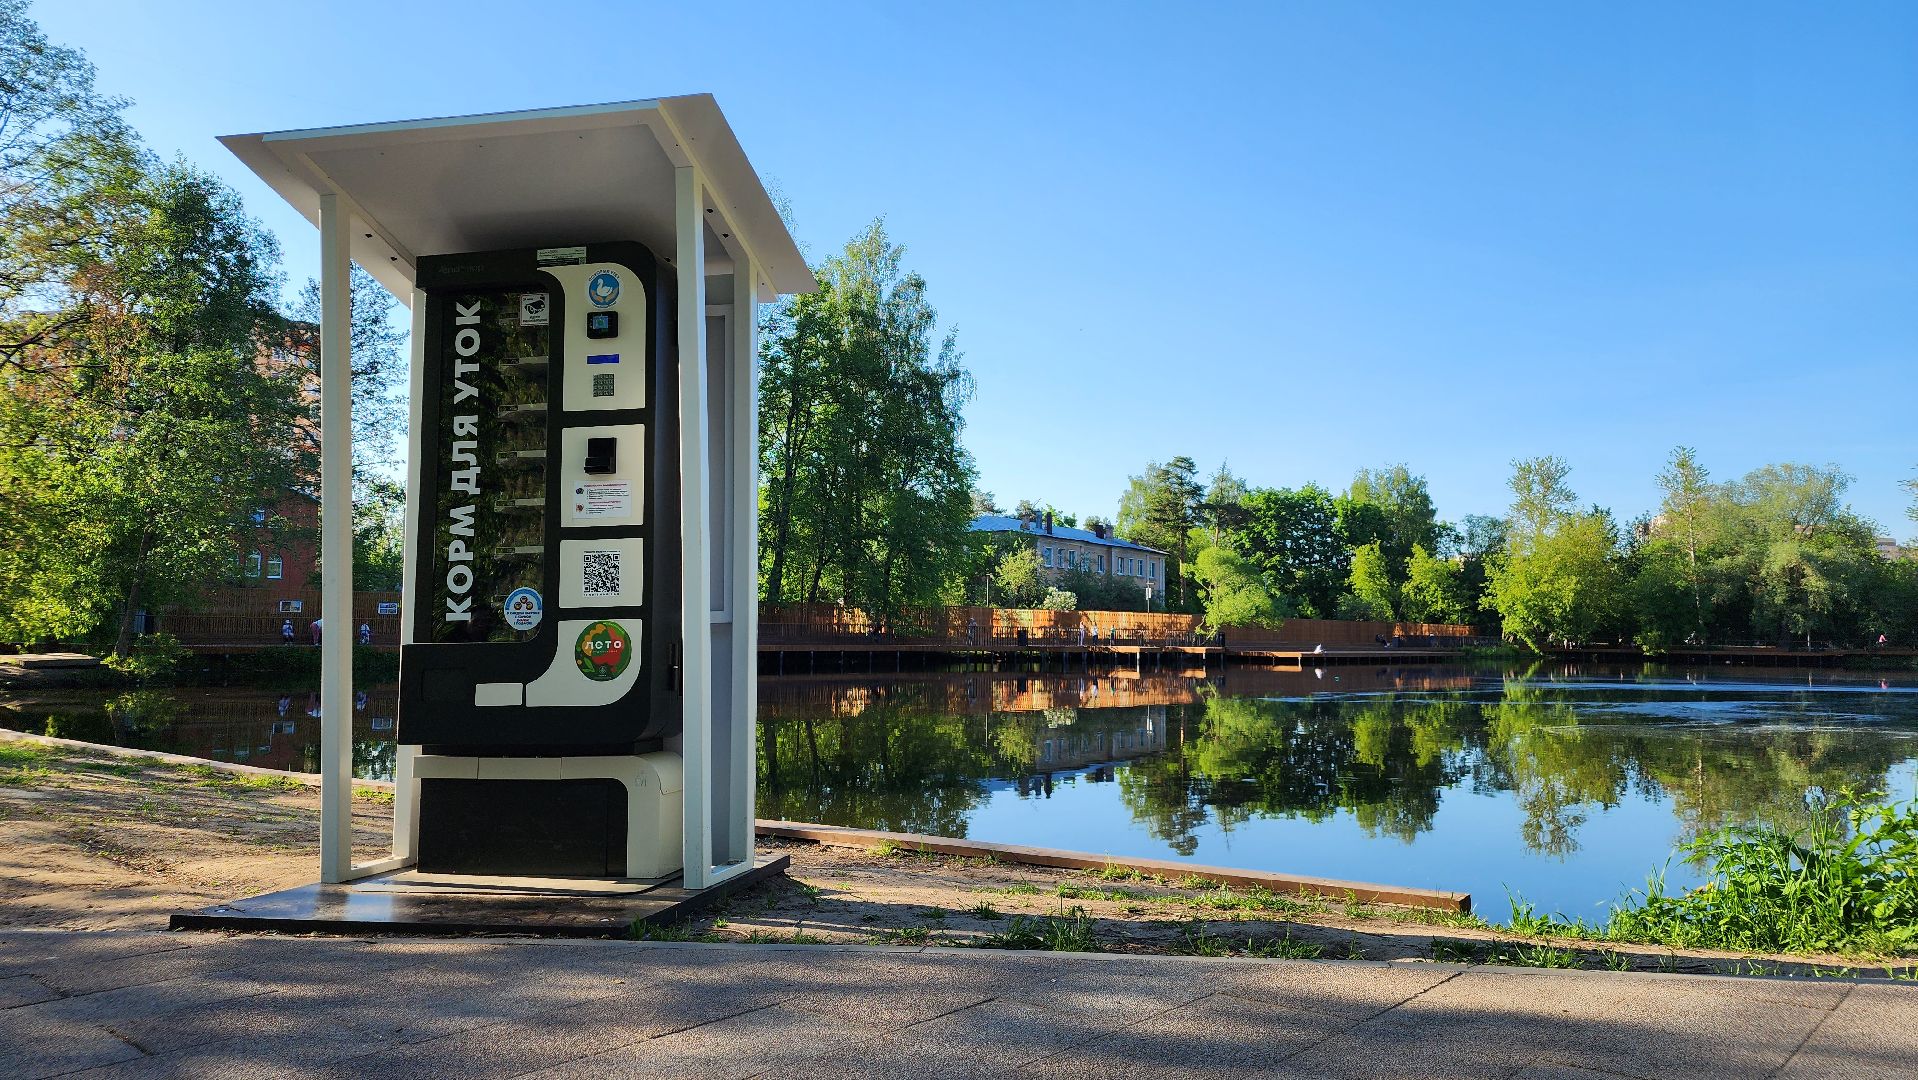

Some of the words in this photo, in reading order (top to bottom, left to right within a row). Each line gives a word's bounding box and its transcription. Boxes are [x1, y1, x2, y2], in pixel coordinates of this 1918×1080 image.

[453, 300, 481, 405] УТОК
[451, 415, 481, 495] ДЛЯ
[446, 505, 476, 622] КОРМ
